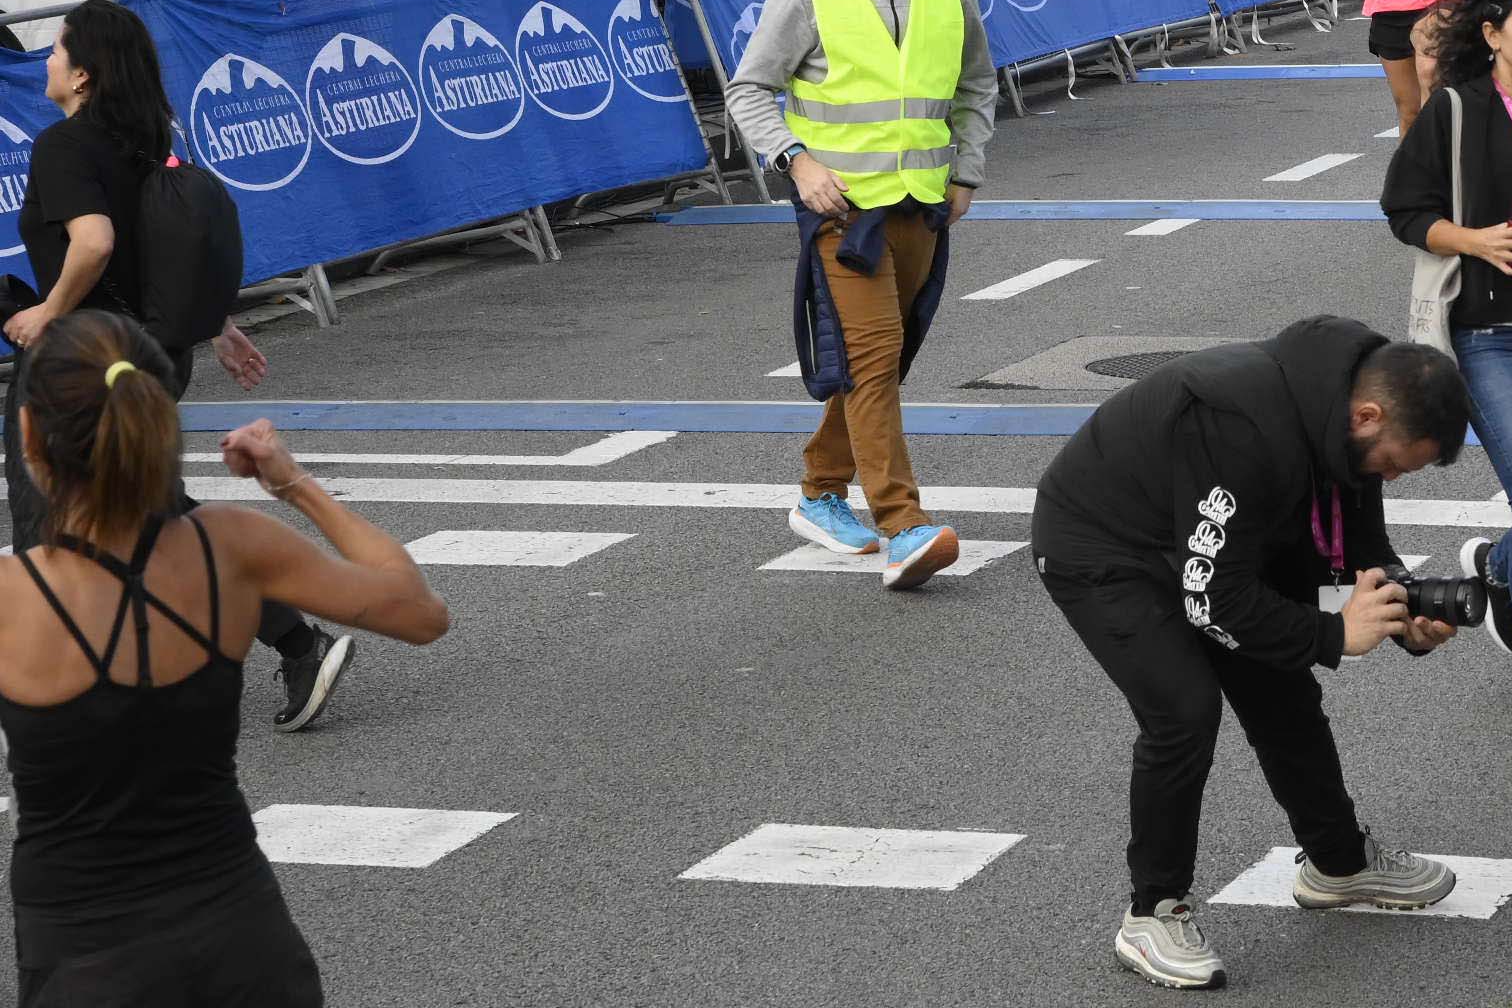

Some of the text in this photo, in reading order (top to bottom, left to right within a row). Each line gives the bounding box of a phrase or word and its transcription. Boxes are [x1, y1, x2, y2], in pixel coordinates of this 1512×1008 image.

[438, 52, 504, 73] CENTRAL LECHERA
[532, 37, 593, 57] CENTRAL LECHERA
[617, 35, 678, 77] ASTUR
[326, 70, 401, 96] CENTRAL LECHERA
[428, 64, 520, 113] ASTURIANA
[524, 50, 609, 95] ASTURIANA
[213, 93, 290, 119] CENTRAL LECHERA
[316, 87, 416, 139] ASTURIANA
[202, 111, 307, 164] ASTURIANA
[0, 150, 31, 166] ECHER
